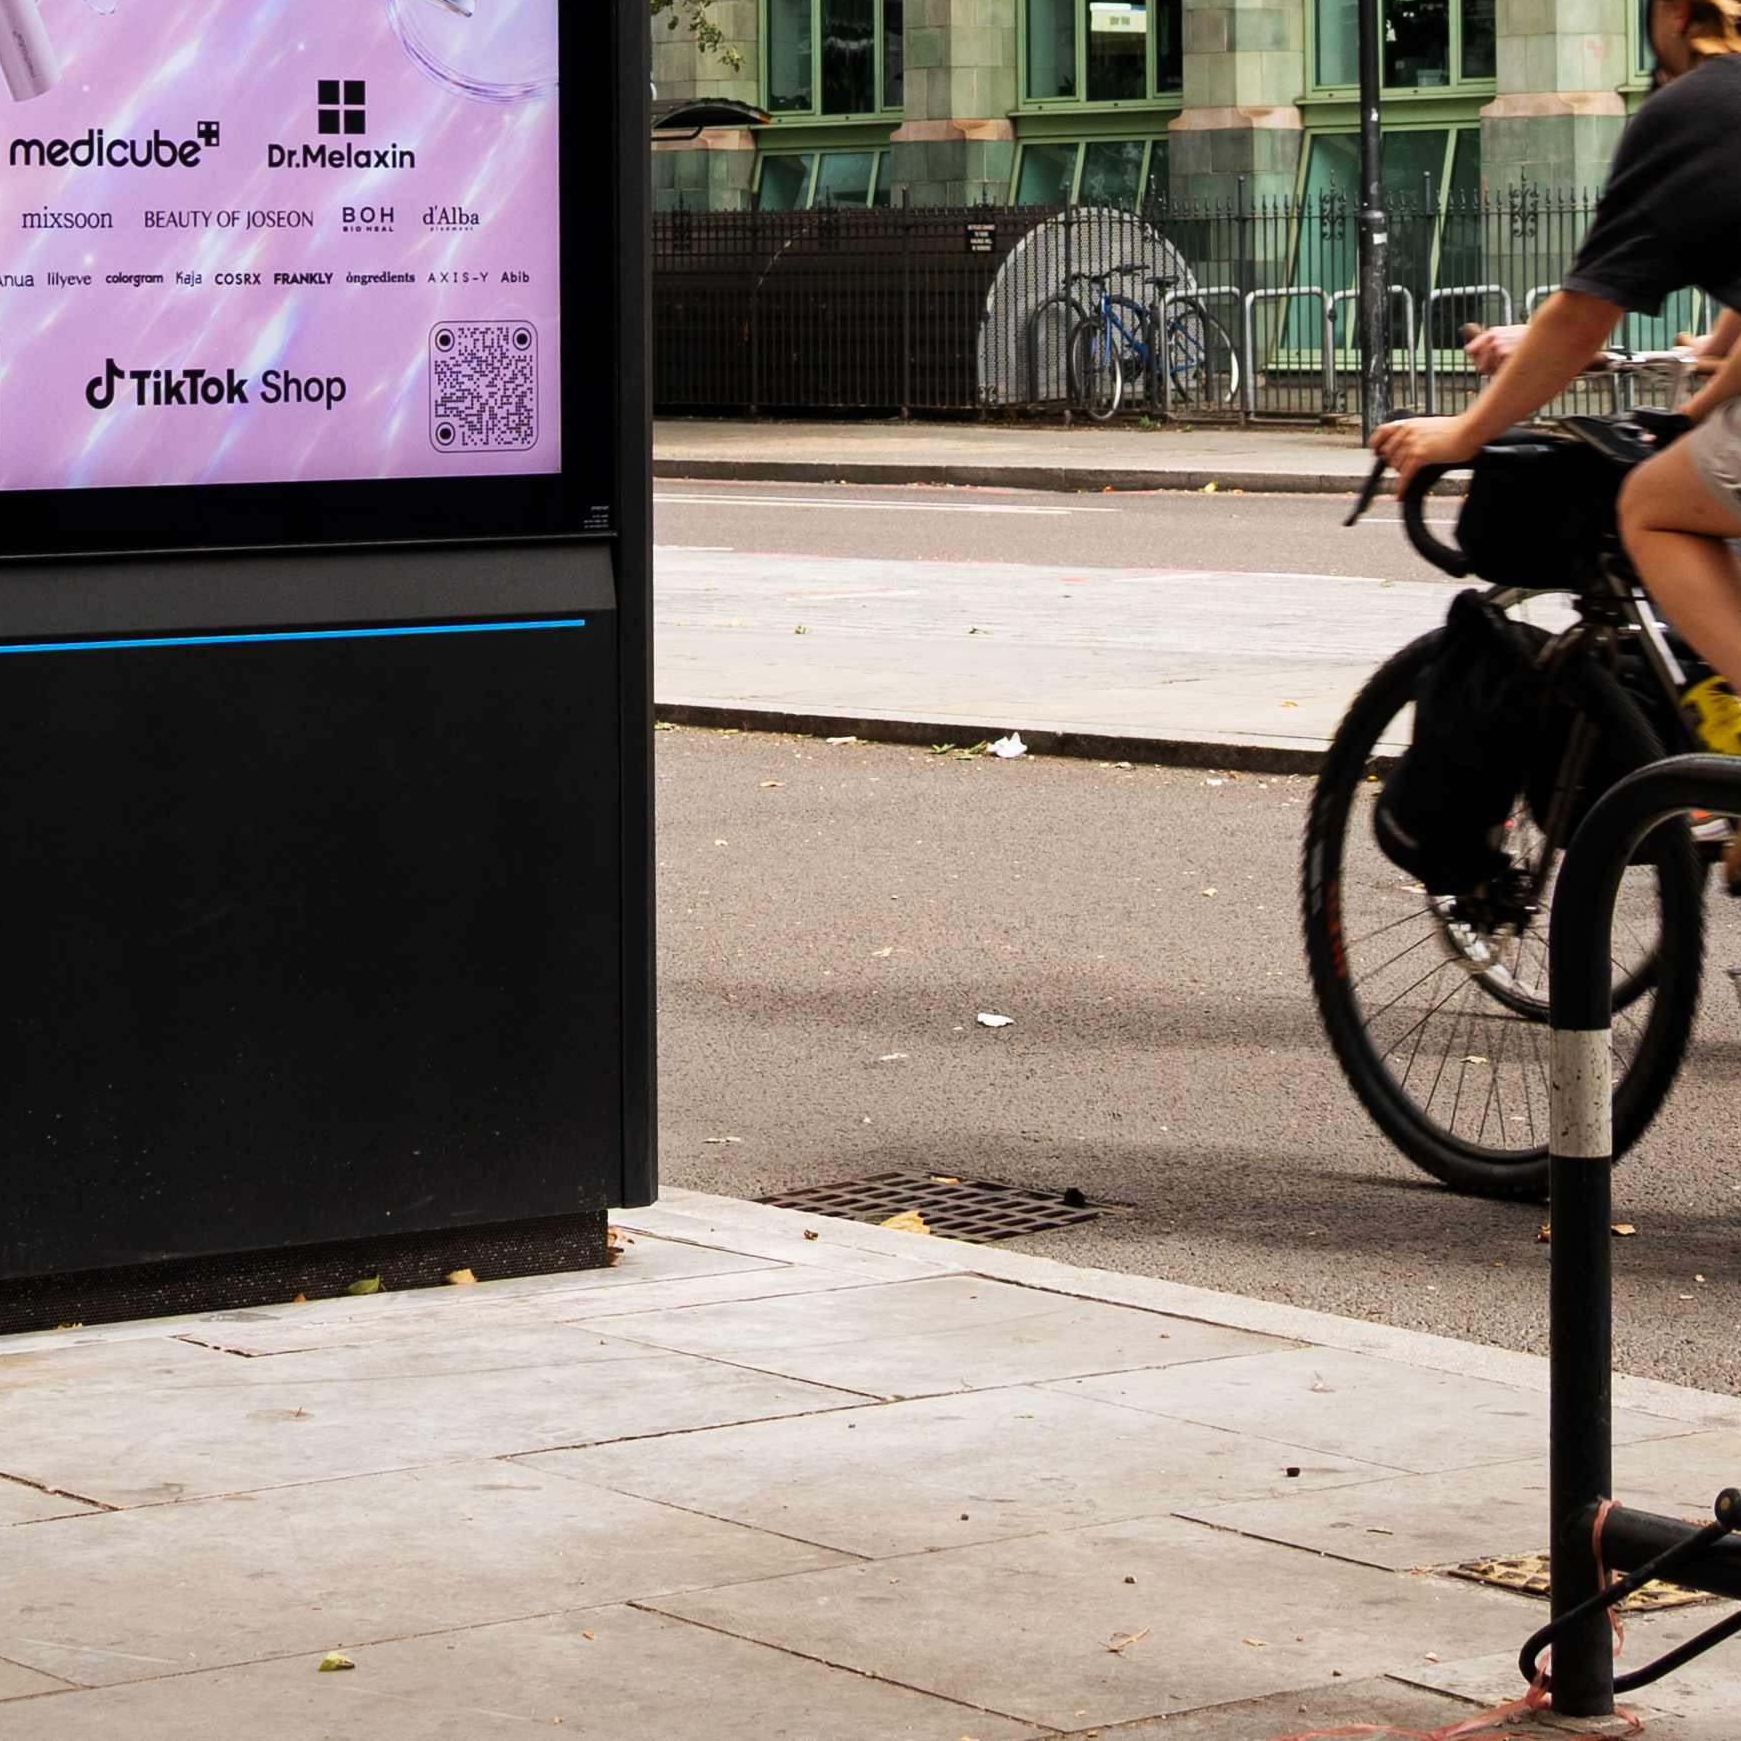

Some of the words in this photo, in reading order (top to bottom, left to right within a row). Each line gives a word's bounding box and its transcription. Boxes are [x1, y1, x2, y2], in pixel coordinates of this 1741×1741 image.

[10, 129, 201, 167] medicube
[268, 142, 415, 168] Dr.Melaxin
[22, 206, 113, 228] mixsoon
[145, 211, 212, 228] BEAUTY
[217, 211, 238, 227] OF
[246, 211, 313, 230] JOSEON
[343, 207, 394, 223] BOH
[423, 205, 479, 225] d'Alba
[48, 272, 91, 288] lilyeve
[106, 272, 163, 287] colorgram
[176, 271, 202, 287] Kaja
[215, 273, 261, 285] COSRX
[274, 273, 333, 285] FRANKLY
[428, 272, 488, 283] AXIS-Y
[501, 272, 529, 282] Abib
[130, 369, 249, 405] TikTok
[260, 370, 346, 410] Shop
